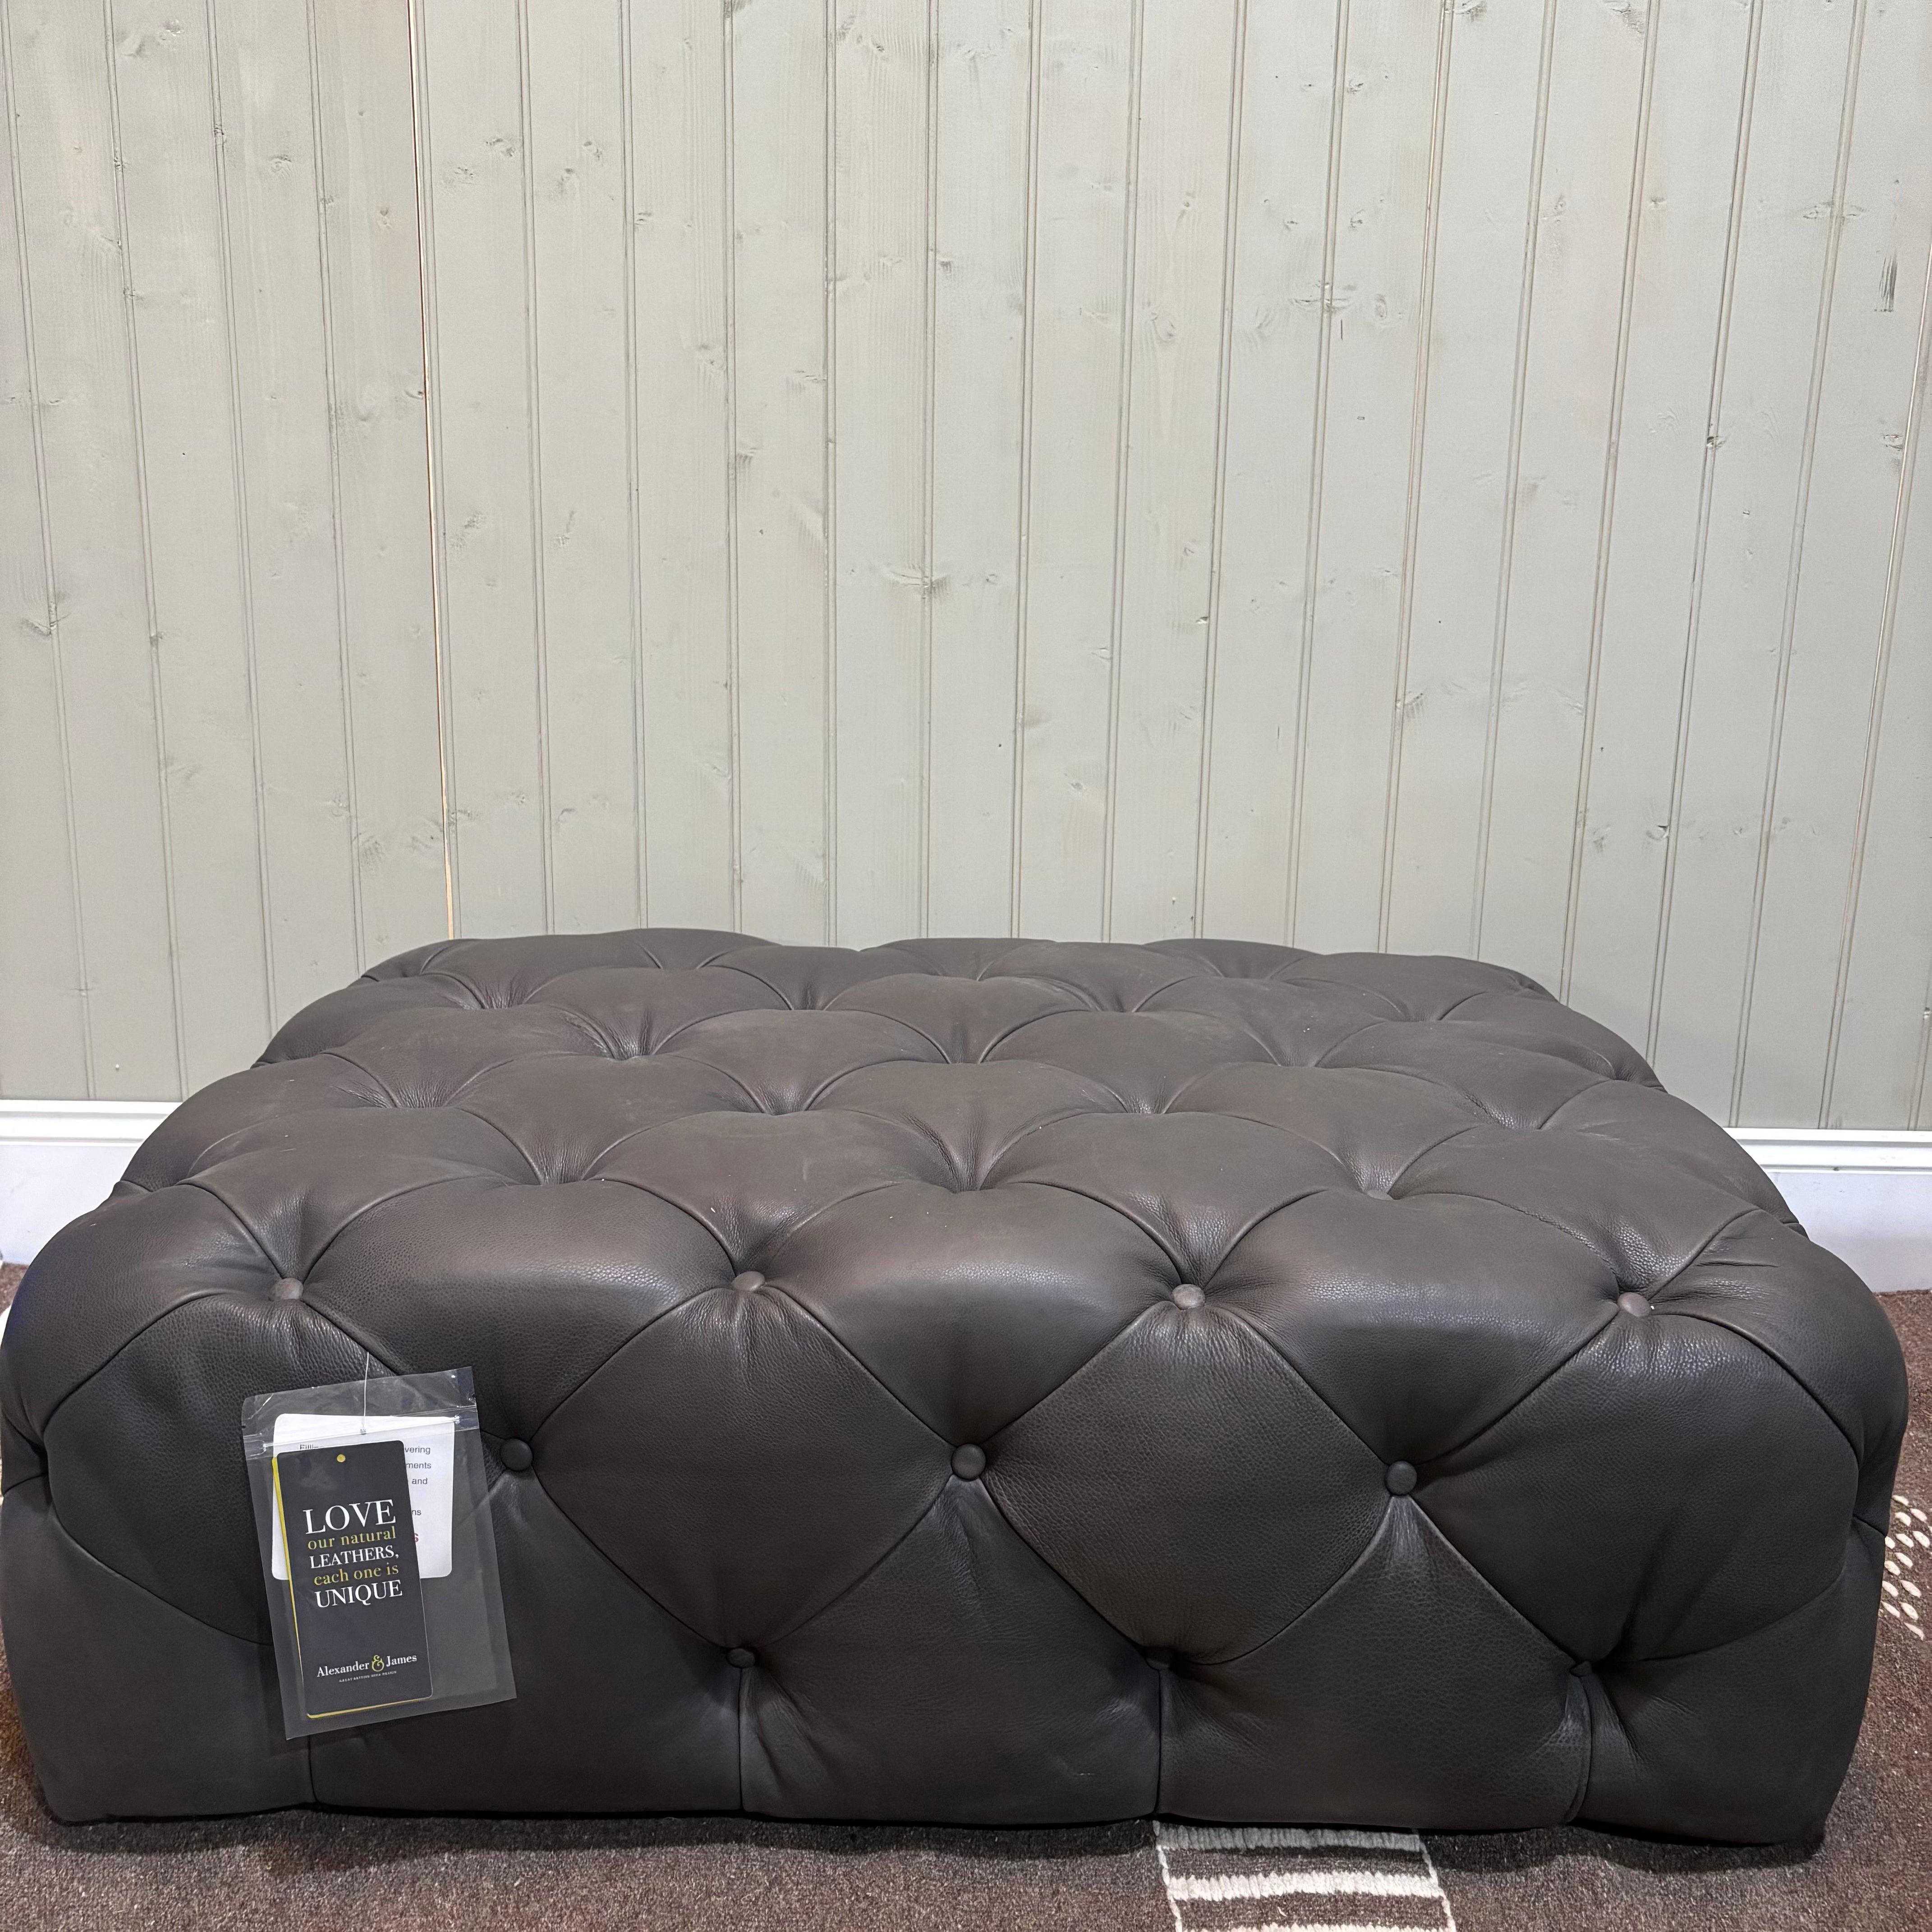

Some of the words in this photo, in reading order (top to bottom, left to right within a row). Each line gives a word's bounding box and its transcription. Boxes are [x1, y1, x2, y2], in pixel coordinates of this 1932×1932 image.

[405, 1446, 431, 1455] vering
[303, 1499, 396, 1534] LOVE
[308, 1537, 335, 1550] our
[341, 1526, 396, 1546] natural
[309, 1545, 399, 1569] LEATHERS,
[314, 1569, 349, 1586] each
[354, 1567, 382, 1579] one
[386, 1562, 399, 1575] is
[314, 1579, 403, 1608] UNIQUE
[317, 1661, 369, 1677] Alexander
[371, 1655, 384, 1672] &
[386, 1655, 417, 1667] James
